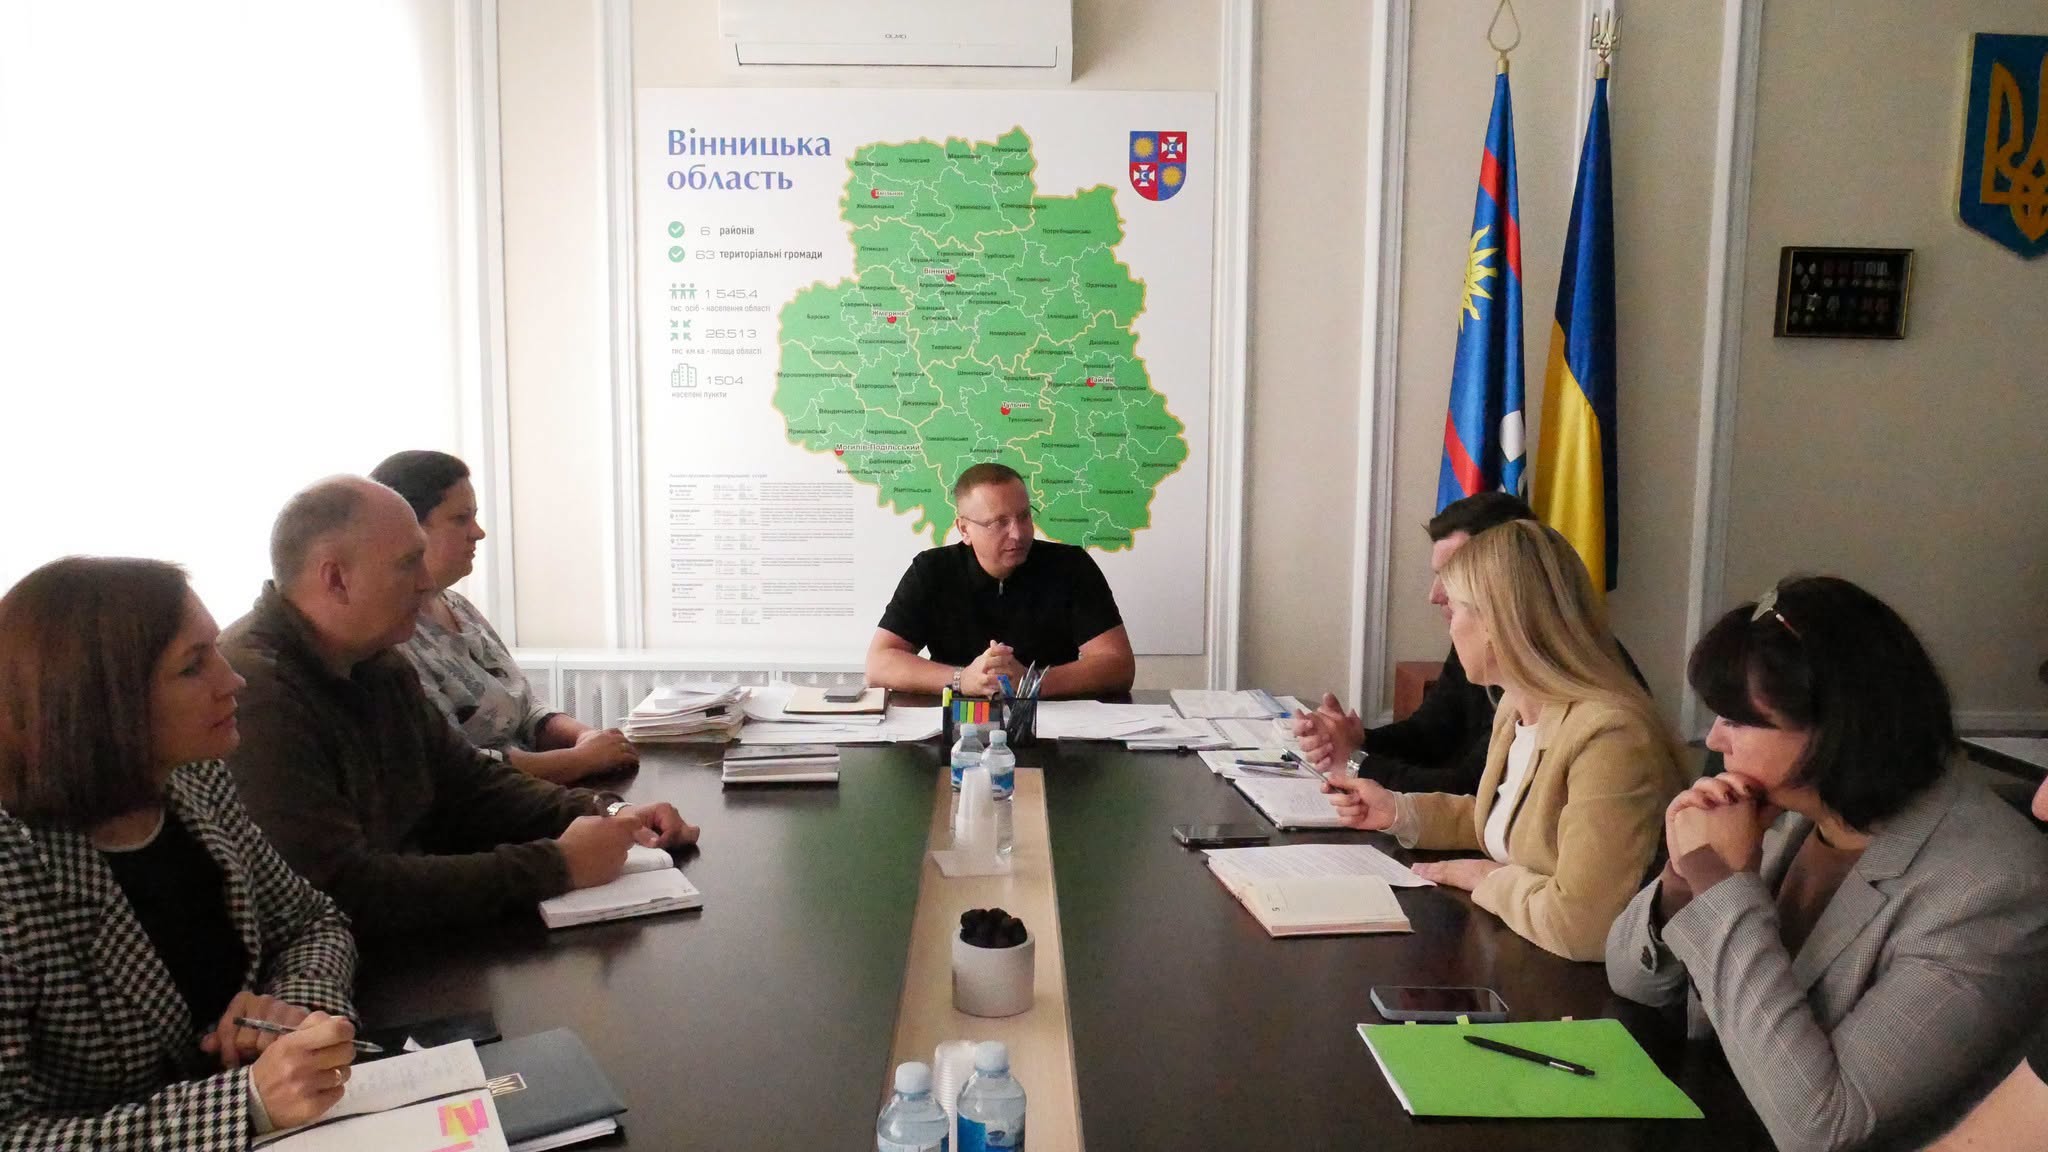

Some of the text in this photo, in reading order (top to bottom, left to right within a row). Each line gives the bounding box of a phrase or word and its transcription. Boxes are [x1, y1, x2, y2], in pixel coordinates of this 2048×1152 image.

[667, 126, 832, 157] Вінницька
[666, 163, 793, 191] область
[700, 225, 755, 237] 6 районів
[695, 249, 823, 260] 63 територіальні громади
